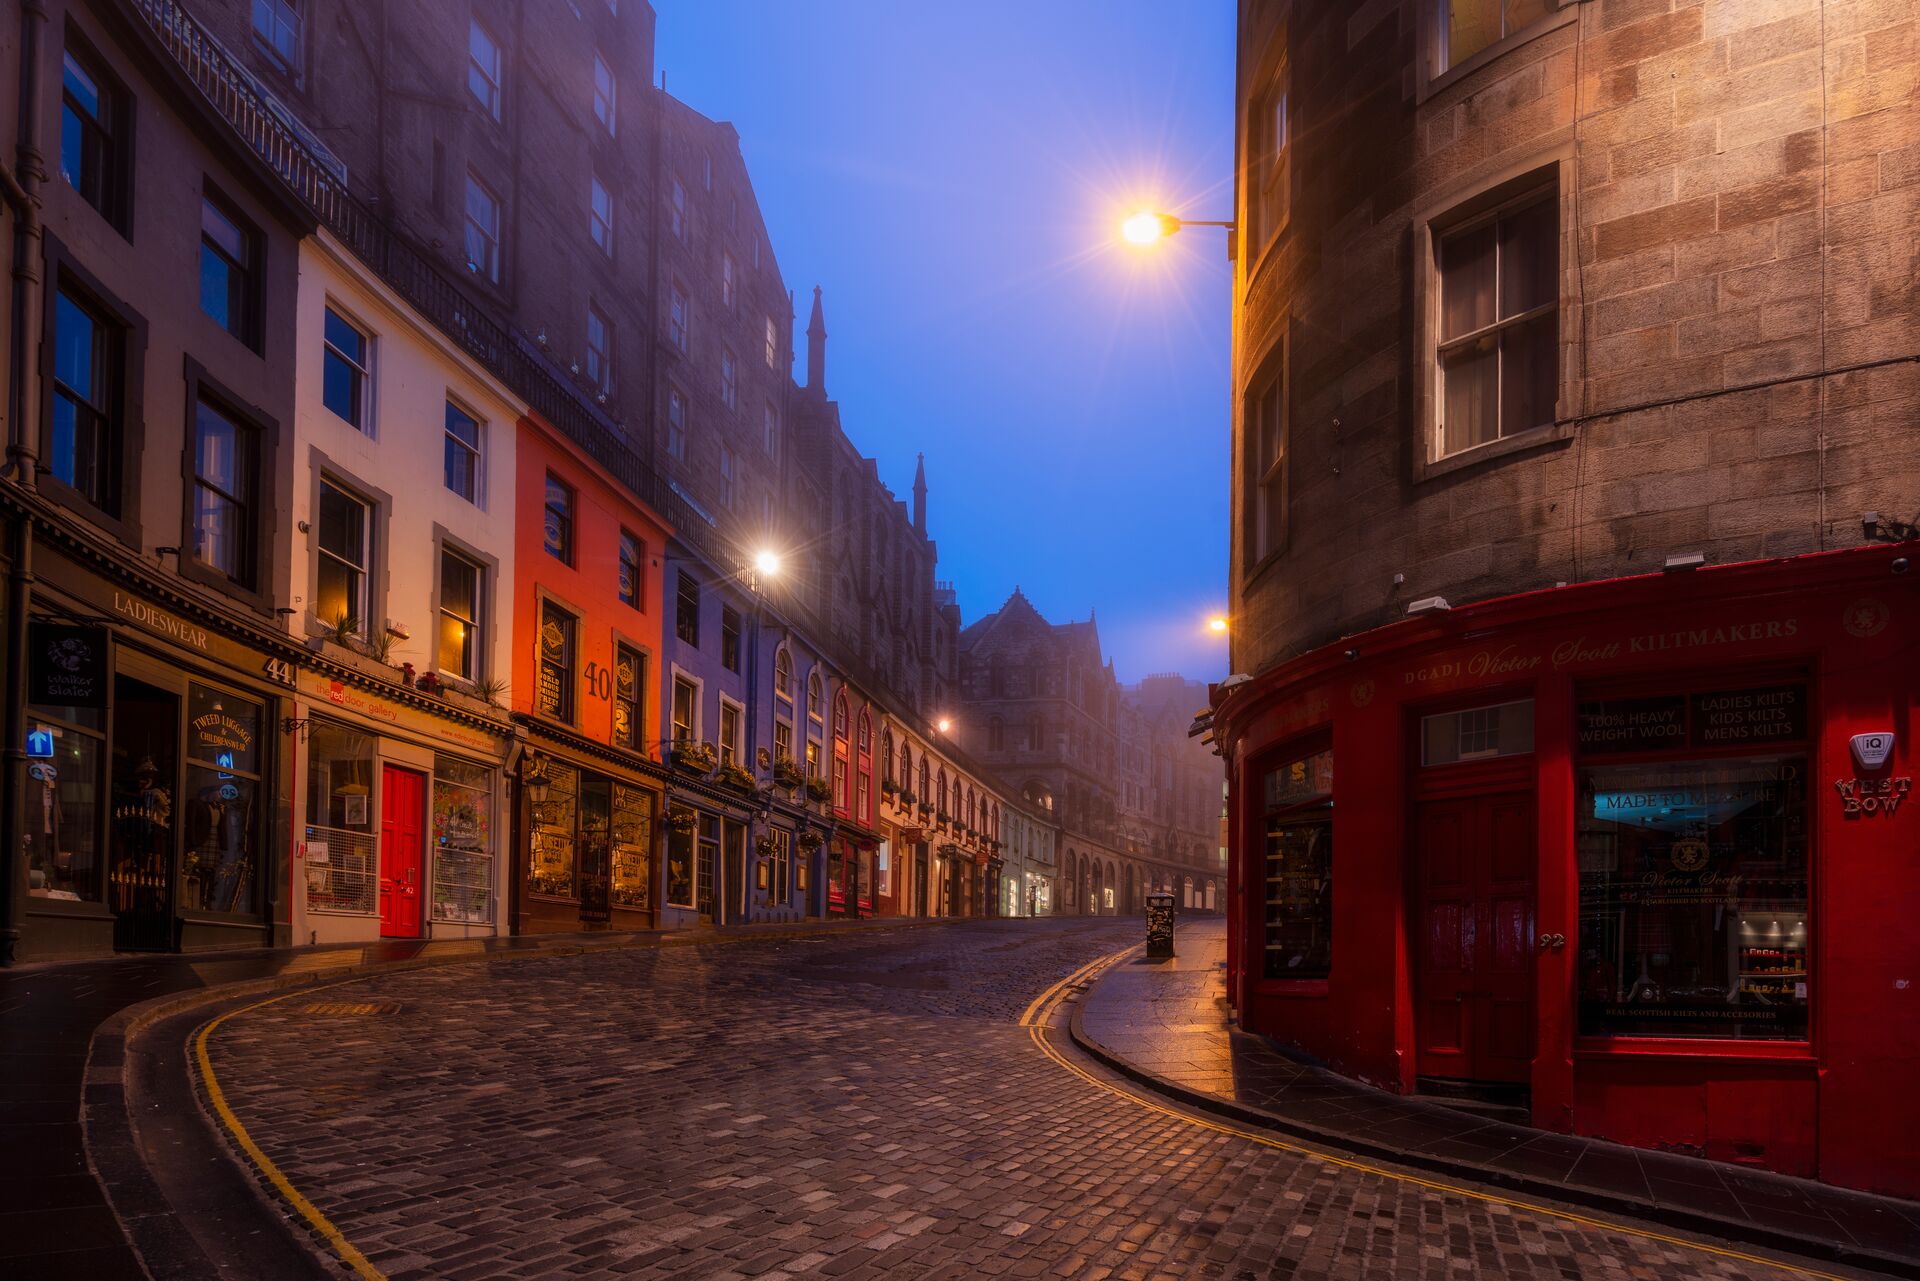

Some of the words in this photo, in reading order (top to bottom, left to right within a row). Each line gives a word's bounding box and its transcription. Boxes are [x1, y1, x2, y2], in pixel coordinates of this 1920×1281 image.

[115, 592, 207, 650] LADIESWEAR
[1467, 643, 1543, 677] Victor
[1551, 634, 1622, 671] Scott
[1630, 617, 1800, 654] KILTMAKERS
[47, 674, 95, 687] Walker
[541, 680, 560, 693] MOUS
[584, 661, 611, 702] 40
[47, 684, 94, 697] Slater
[316, 682, 331, 697] the
[331, 690, 343, 702] red
[345, 694, 366, 708] door
[368, 701, 398, 721] gallery
[1700, 694, 1752, 711] LADIES
[1756, 690, 1796, 707] KILTS
[1587, 711, 1625, 728] 100%
[1628, 711, 1676, 726] HEAVY
[1710, 710, 1744, 726] KIDS
[1747, 707, 1787, 723] KILTS
[193, 713, 220, 730] TWEED
[222, 715, 254, 745] LUGGAGE
[1578, 727, 1637, 743] WEIGHT
[1639, 723, 1687, 738] WOOL
[1704, 725, 1749, 741] MENS
[1753, 721, 1793, 737] KILTS
[200, 731, 247, 752] CHILDRENSWEAR
[1866, 738, 1882, 748] iQ
[1835, 776, 1912, 797] WEST
[1607, 794, 1657, 809] MADE
[1662, 793, 1686, 807] TO
[1844, 795, 1901, 812] BOW
[1642, 869, 1693, 888] Victor
[1698, 871, 1744, 888] Scott
[405, 887, 414, 895] 42
[1690, 897, 1698, 905] IN
[1700, 897, 1740, 905] SCOTLAND
[1539, 933, 1565, 948] 92
[1605, 1008, 1626, 1016] REAL
[1628, 1009, 1671, 1017] SCOTTISH
[1720, 1011, 1777, 1019] ACCESORIES
